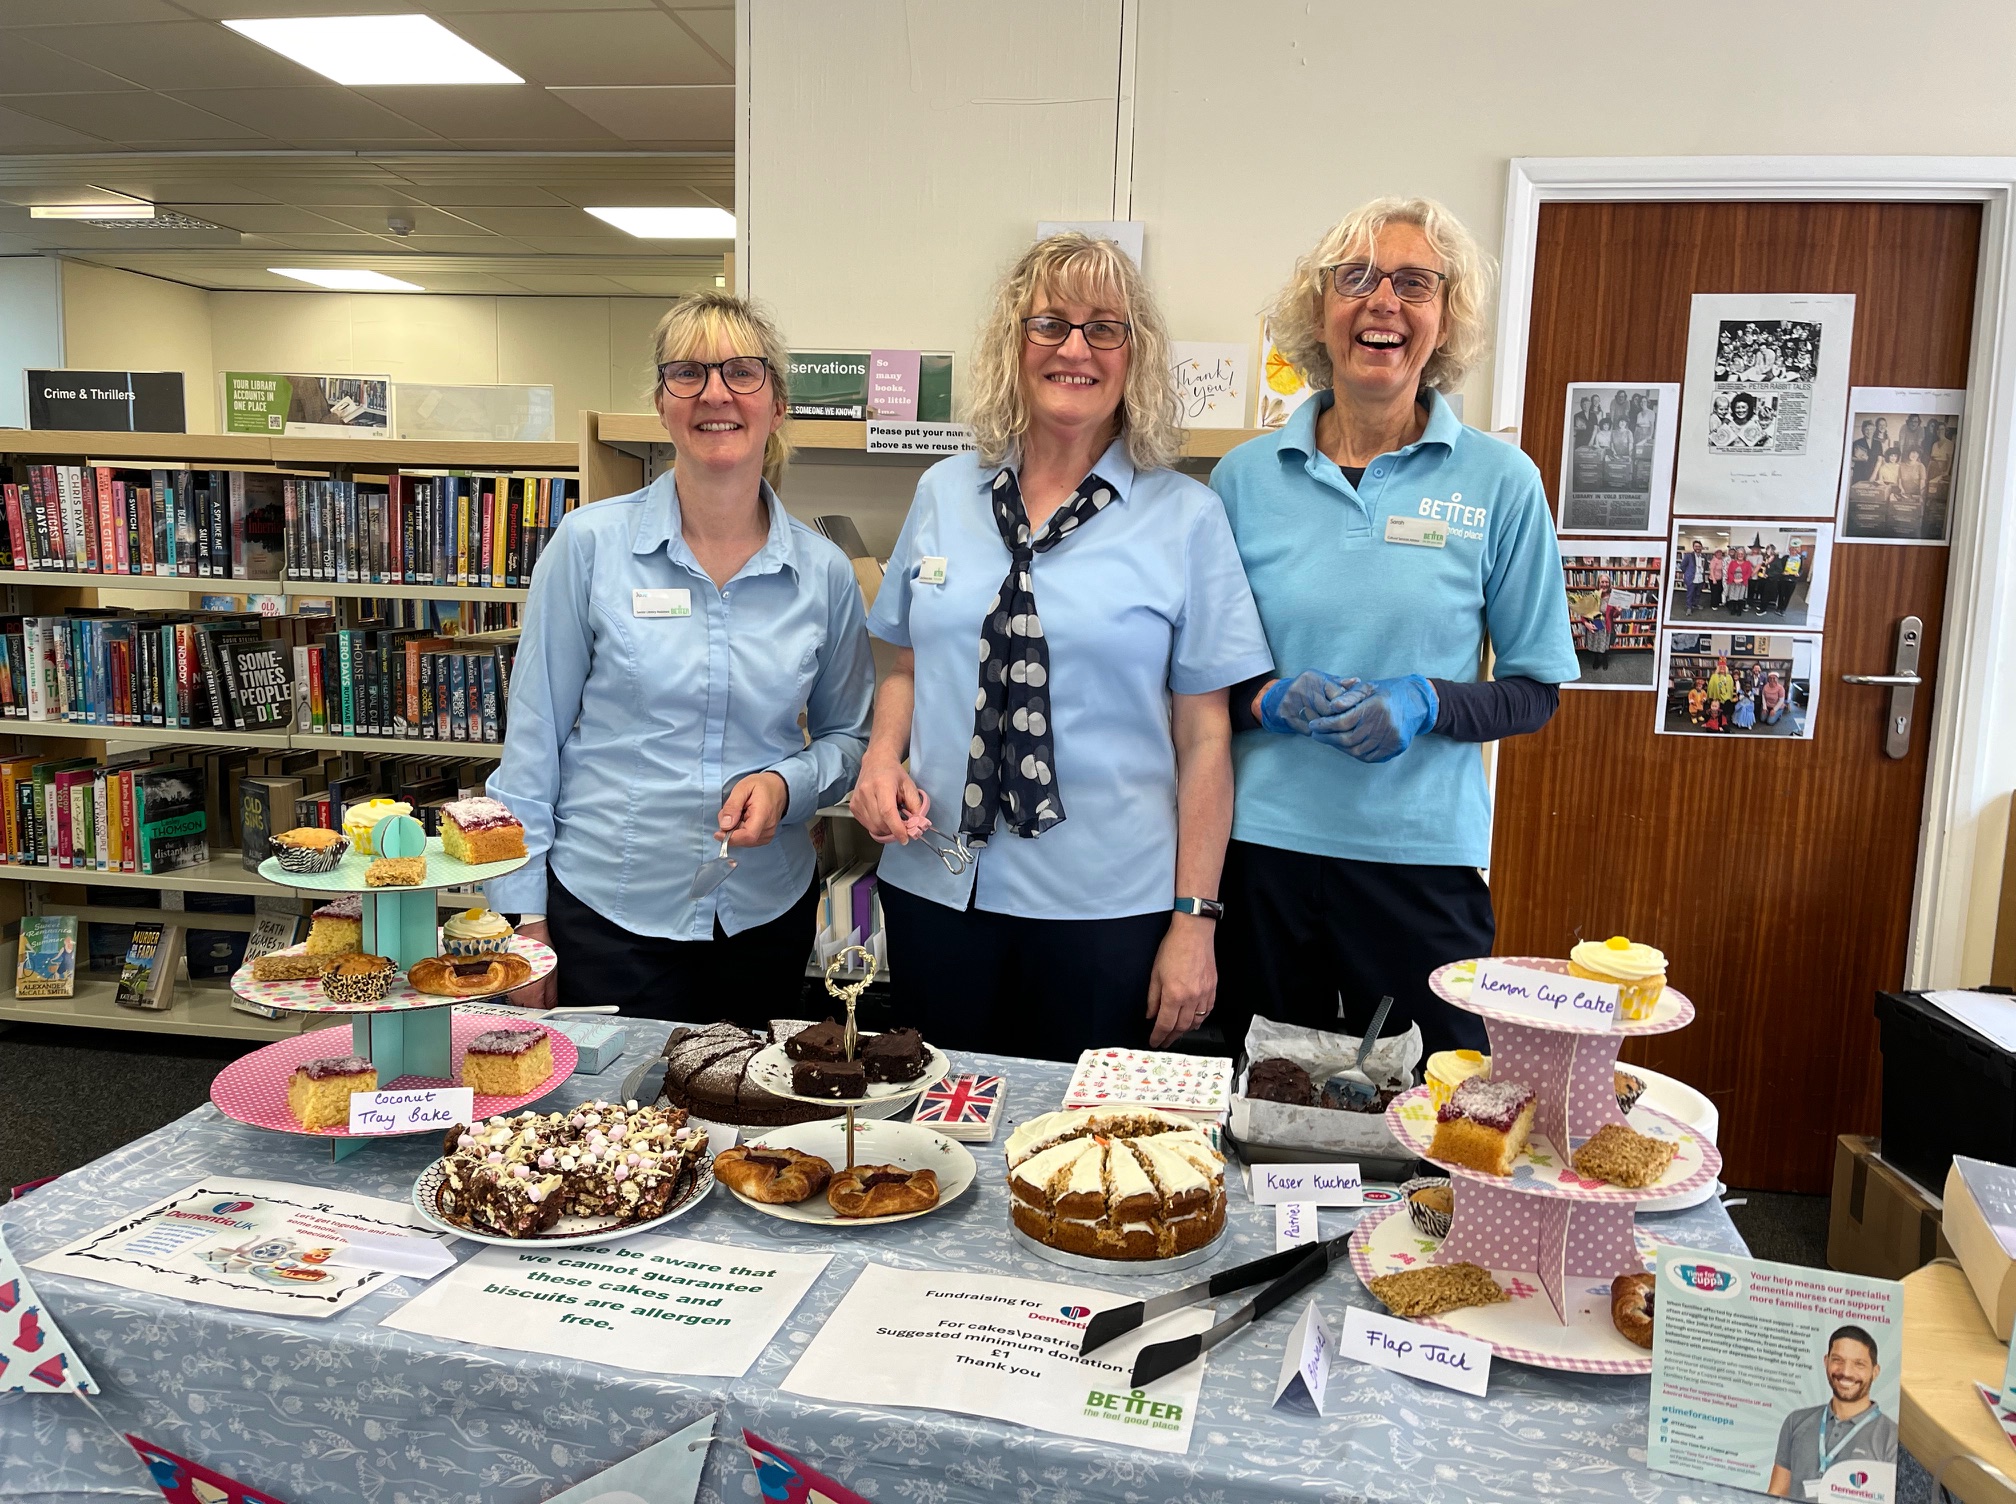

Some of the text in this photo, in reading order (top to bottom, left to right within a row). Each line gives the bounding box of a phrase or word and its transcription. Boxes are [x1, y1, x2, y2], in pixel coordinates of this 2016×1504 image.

[783, 363, 866, 375] eservations
[877, 360, 888, 368] So
[1170, 358, 1229, 389] Thank
[233, 379, 276, 390] YOUR LIBRARY
[876, 372, 902, 382] many
[1749, 382, 1769, 390] PETER
[1794, 383, 1812, 391] TALES
[44, 388, 136, 400] Crime & Thrillers
[234, 390, 274, 402] ACCOUNTS IN
[875, 384, 906, 393] books,
[234, 400, 267, 412] ONE PLACE
[888, 396, 912, 404] little
[796, 406, 824, 415] SOMEONE
[824, 407, 834, 416] WE
[870, 426, 902, 436] Please
[904, 428, 920, 438] put
[922, 430, 944, 438] your
[870, 441, 899, 449] above
[57, 472, 70, 535] CHRIS RYAN
[71, 474, 84, 536] CHRIS RYAN
[1418, 494, 1486, 528] BETTER
[36, 507, 48, 534] DAYS
[46, 502, 60, 541] OUTCAST
[129, 498, 137, 530] SWITCH
[214, 510, 222, 522] SPY
[1390, 518, 1404, 526] Sarah
[100, 494, 112, 560] FINAL GIRLS
[214, 523, 222, 538] LIKE
[510, 504, 518, 550] Reputation
[1424, 532, 1444, 540] BETTER
[200, 542, 208, 556] LANE
[215, 538, 222, 550] ME
[262, 602, 275, 611] OLD
[339, 634, 350, 660] ZERO
[178, 630, 187, 684] MR NOBODY
[237, 650, 282, 672] SOME-
[354, 643, 364, 680] HOUSE
[240, 667, 286, 689] TIMES
[341, 662, 350, 686] DAYS
[206, 671, 220, 717] REMAIN SILENT
[240, 684, 292, 707] PEOPLE
[256, 702, 282, 723] DIE
[244, 796, 262, 814] OLD
[152, 820, 202, 837] THOMSON
[244, 812, 264, 831] SINS
[154, 840, 204, 859] distant dead
[132, 930, 160, 944] MURDER
[258, 920, 286, 936] DEATH
[31, 938, 65, 948] Summer
[250, 932, 285, 950] COMES TO
[137, 944, 156, 958] FARM
[24, 982, 66, 990] ALEXANDER
[1481, 973, 1614, 1013] Lemon Cup Cake
[375, 1092, 436, 1104] Coconut
[358, 1106, 453, 1130] Tray Bake
[1267, 1172, 1362, 1190] Kaser Kuchen
[286, 1218, 312, 1228] some
[294, 1212, 385, 1236] Let's get together and
[1284, 1203, 1300, 1238] Pastries
[296, 1228, 339, 1242] specialist
[616, 1248, 644, 1258] be
[650, 1255, 722, 1272] aware
[728, 1266, 778, 1278] that
[518, 1254, 764, 1294] we cannot guarantee
[1686, 1270, 1704, 1278] Time
[1692, 1277, 1723, 1287] cuppa
[526, 1270, 723, 1308] these cakes and
[1750, 1271, 1891, 1302] Your help means our specialist
[483, 1283, 732, 1327] biscuits are allergen
[926, 1290, 1042, 1308] Fundraising for
[1750, 1283, 1885, 1312] dementia nurses can support
[1750, 1294, 1891, 1324] more families facing dementia
[559, 1312, 615, 1331] free.
[1028, 1312, 1086, 1330] Dementi
[938, 1320, 1080, 1350] For cakes\pastrie
[876, 1326, 1123, 1372] Suggested minimum donation
[990, 1349, 1010, 1359] £1
[1366, 1330, 1472, 1371] Flap Jack
[956, 1354, 1042, 1379] Thank you
[1086, 1390, 1183, 1421] BETTER
[1662, 1404, 1734, 1426] #timeforacuppa
[1084, 1408, 1180, 1431] the feel good place
